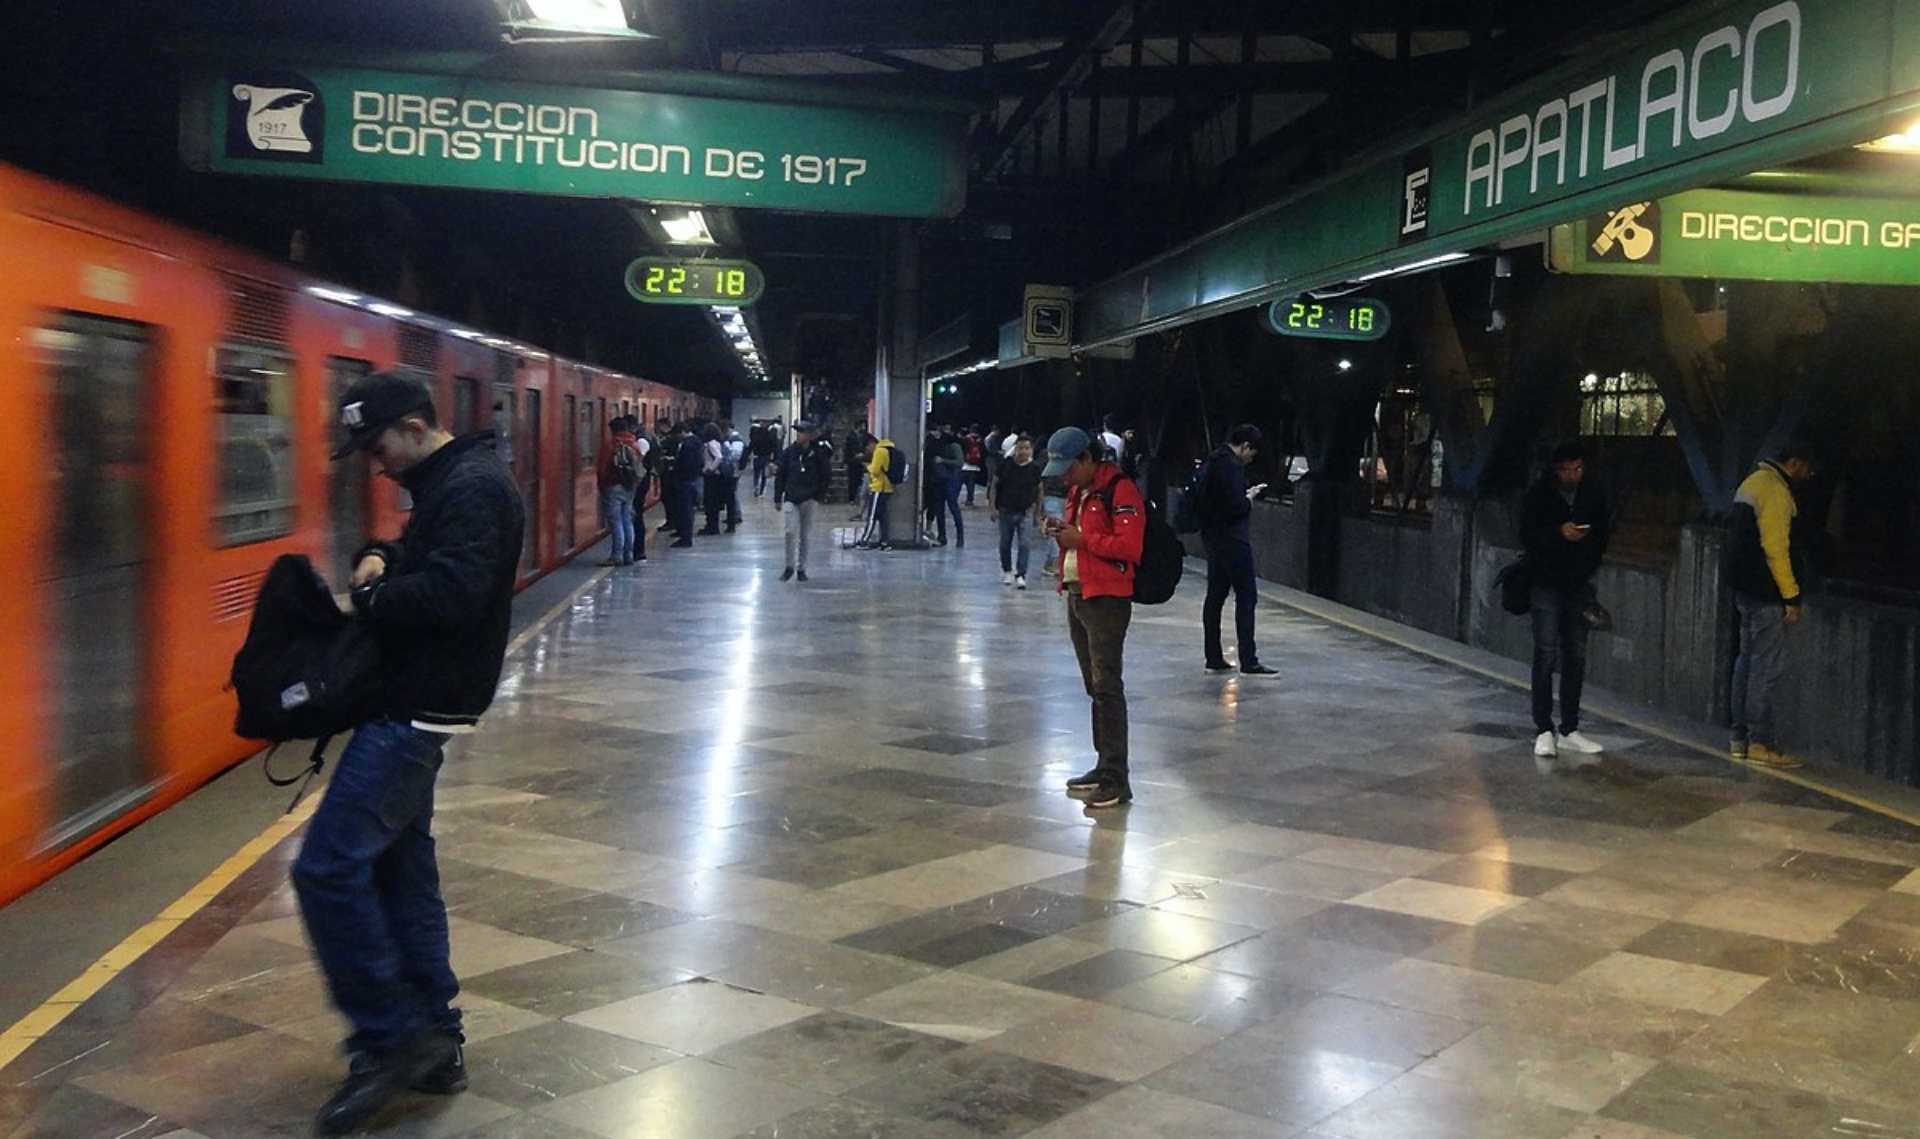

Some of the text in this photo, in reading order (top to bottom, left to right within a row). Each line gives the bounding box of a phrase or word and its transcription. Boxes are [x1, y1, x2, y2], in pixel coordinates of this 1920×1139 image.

[353, 90, 598, 137] DIRECCION
[1463, 0, 1800, 215] APATLACO
[259, 122, 287, 134] 1917
[352, 123, 866, 186] CONSTITUCION DE 1917
[1681, 212, 1869, 246] DIRECCION
[646, 267, 745, 295] 22:18
[1288, 304, 1373, 331] 22:18
